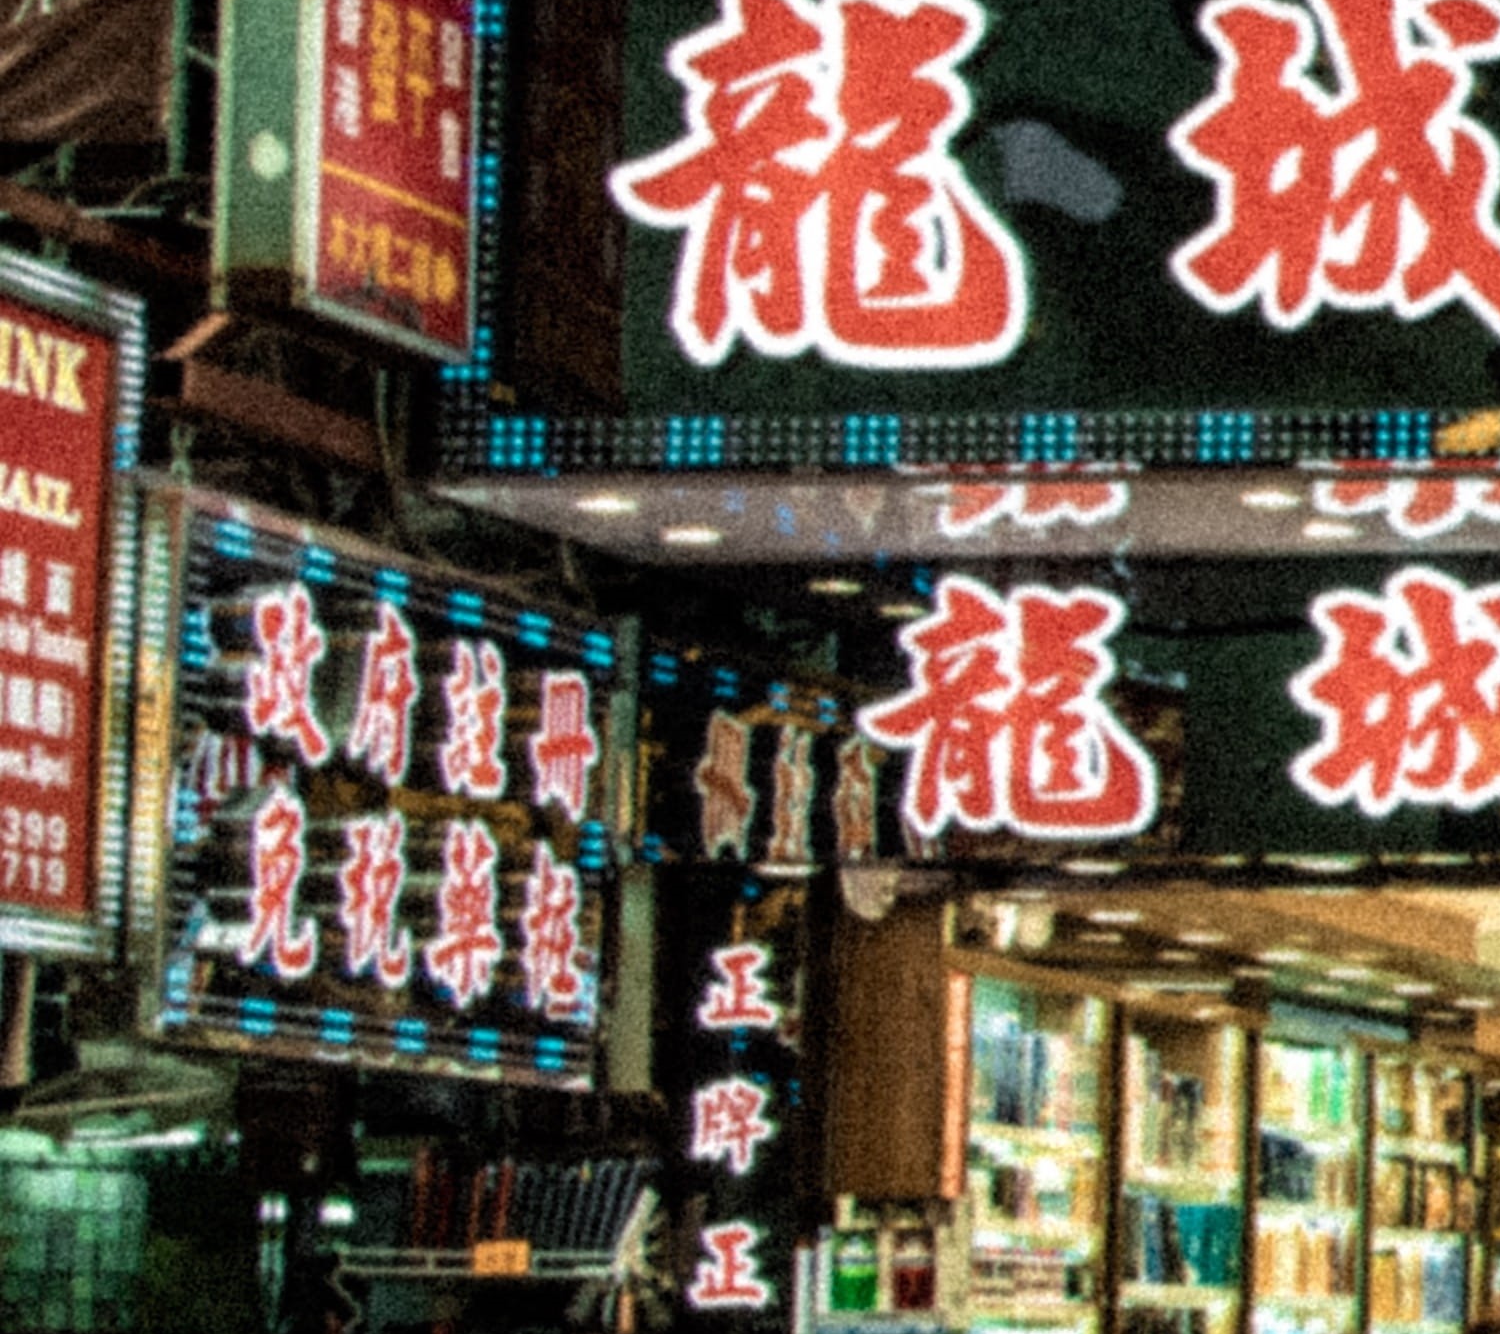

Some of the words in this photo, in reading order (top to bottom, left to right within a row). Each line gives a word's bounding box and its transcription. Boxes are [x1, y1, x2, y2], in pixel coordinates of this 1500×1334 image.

[246, 578, 603, 824] 政府註冊
[239, 783, 587, 1025] 免稅藥粧
[686, 943, 781, 1311] 正牌正
